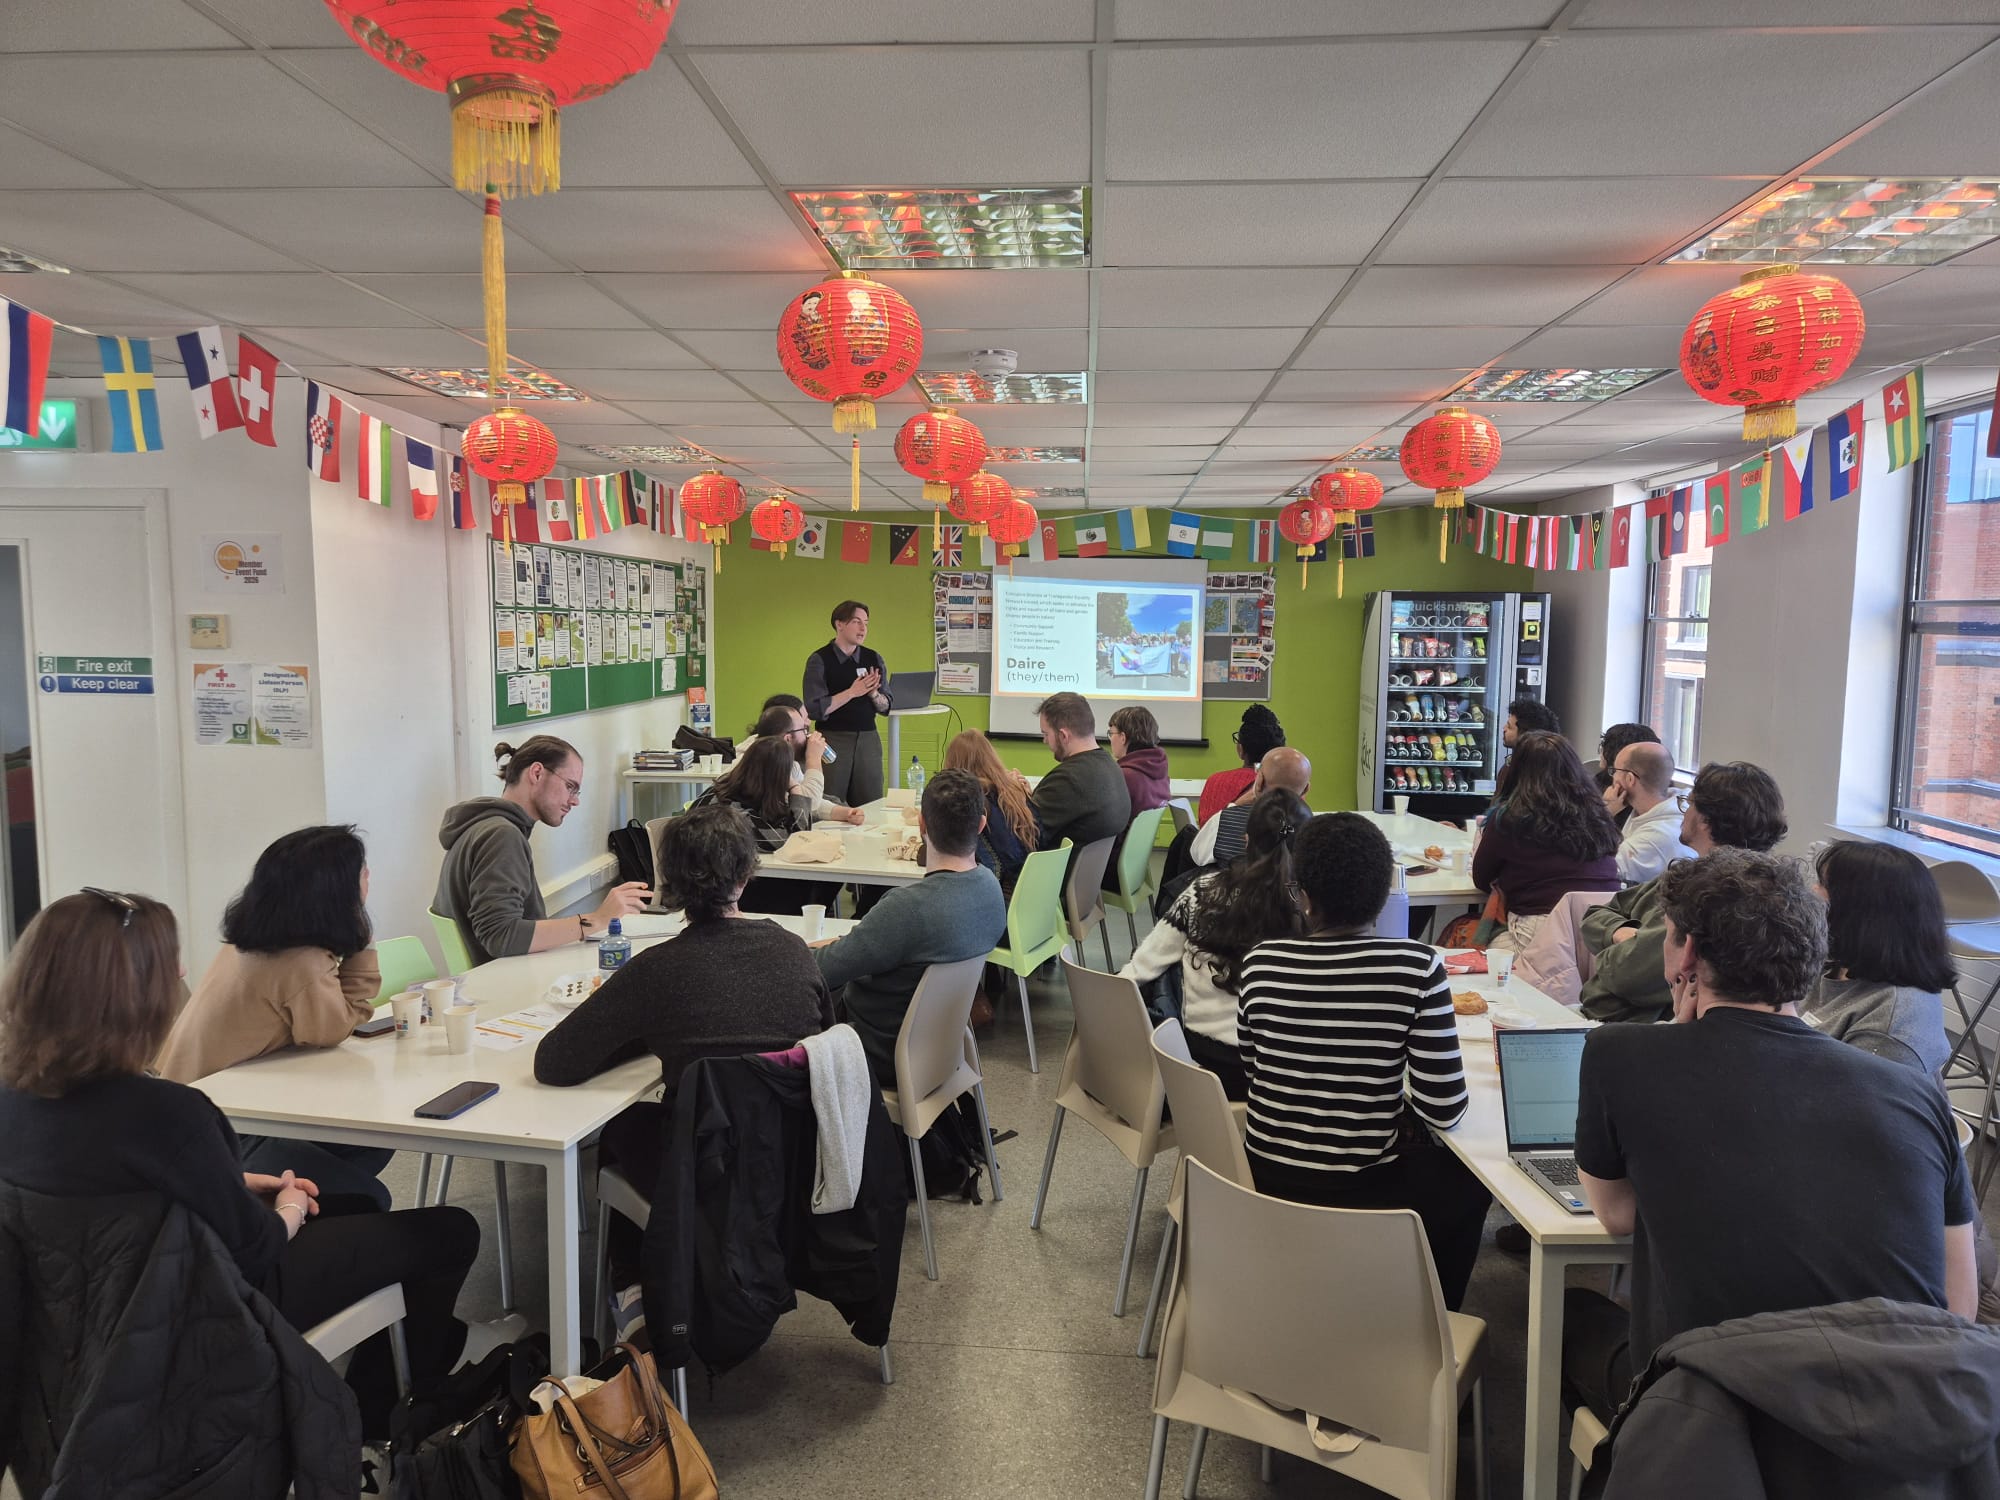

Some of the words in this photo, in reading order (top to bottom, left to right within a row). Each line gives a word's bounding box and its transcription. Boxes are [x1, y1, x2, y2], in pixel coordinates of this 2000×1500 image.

[76, 659, 104, 672] Fire
[107, 659, 133, 672] exit
[1007, 657, 1046, 669] Daire
[1007, 671, 1080, 684] (they/them)
[72, 678, 104, 691] Keep
[108, 678, 140, 690] clear
